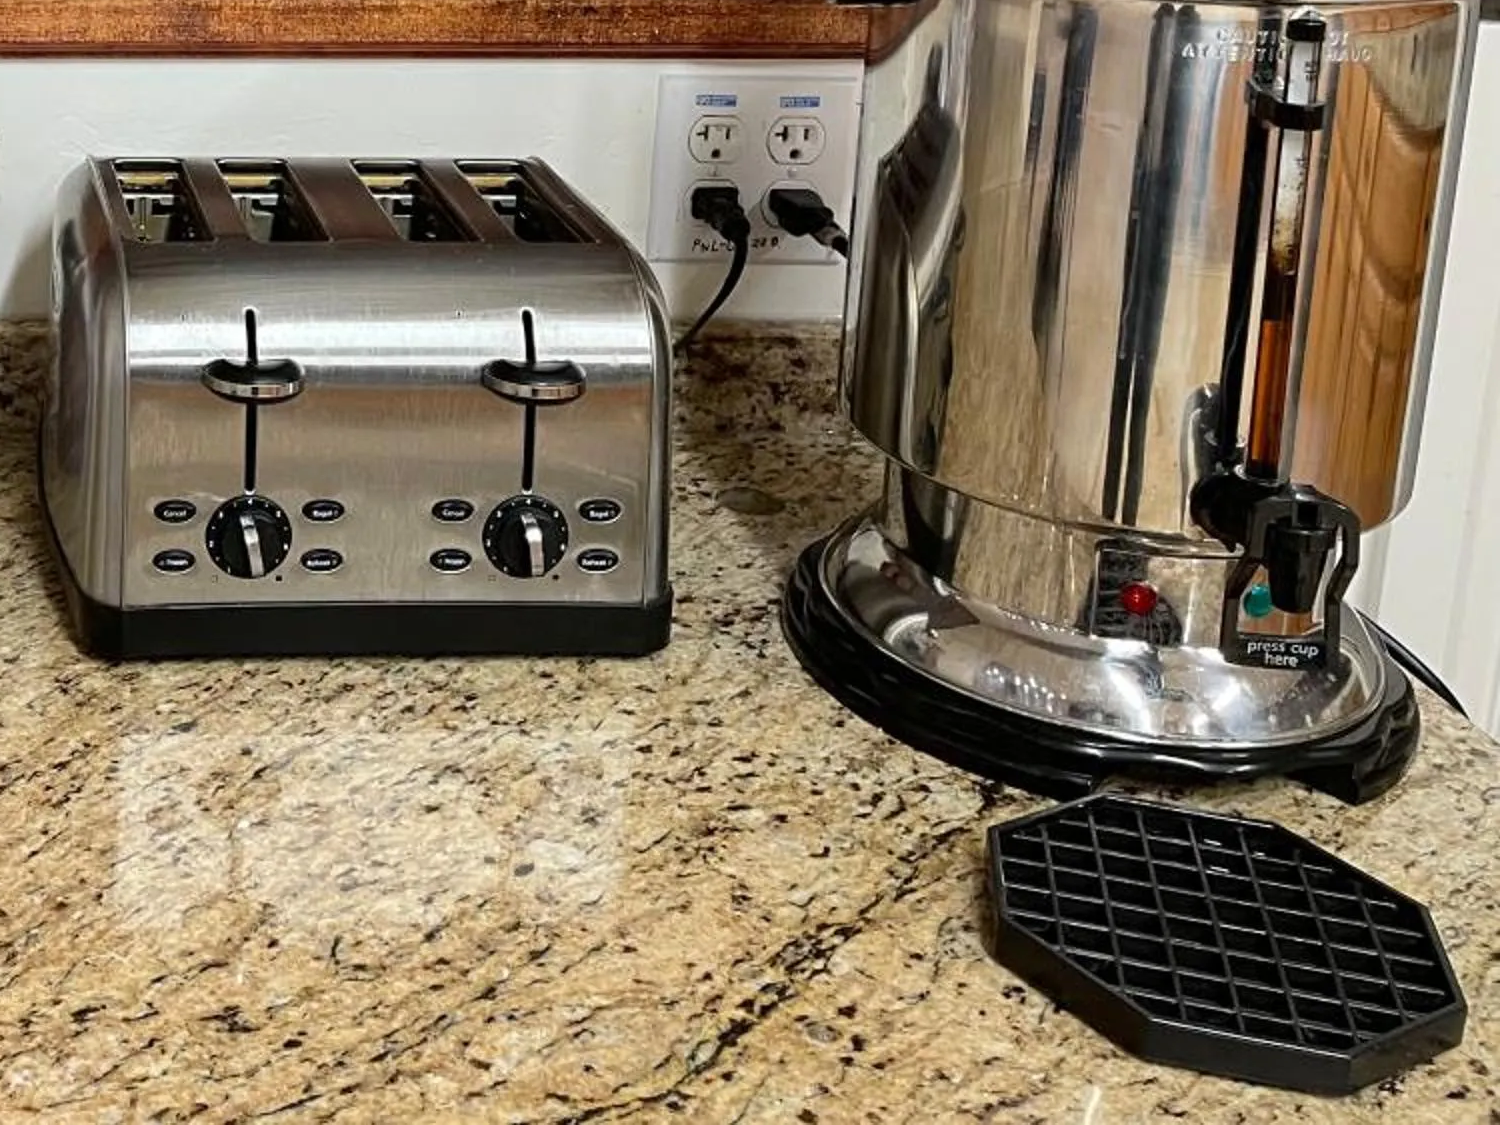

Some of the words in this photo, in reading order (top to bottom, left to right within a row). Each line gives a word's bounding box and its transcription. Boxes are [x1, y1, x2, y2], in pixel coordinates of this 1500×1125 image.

[1247, 642, 1285, 654] press
[1290, 644, 1319, 659] cup
[1265, 651, 1299, 668] here
